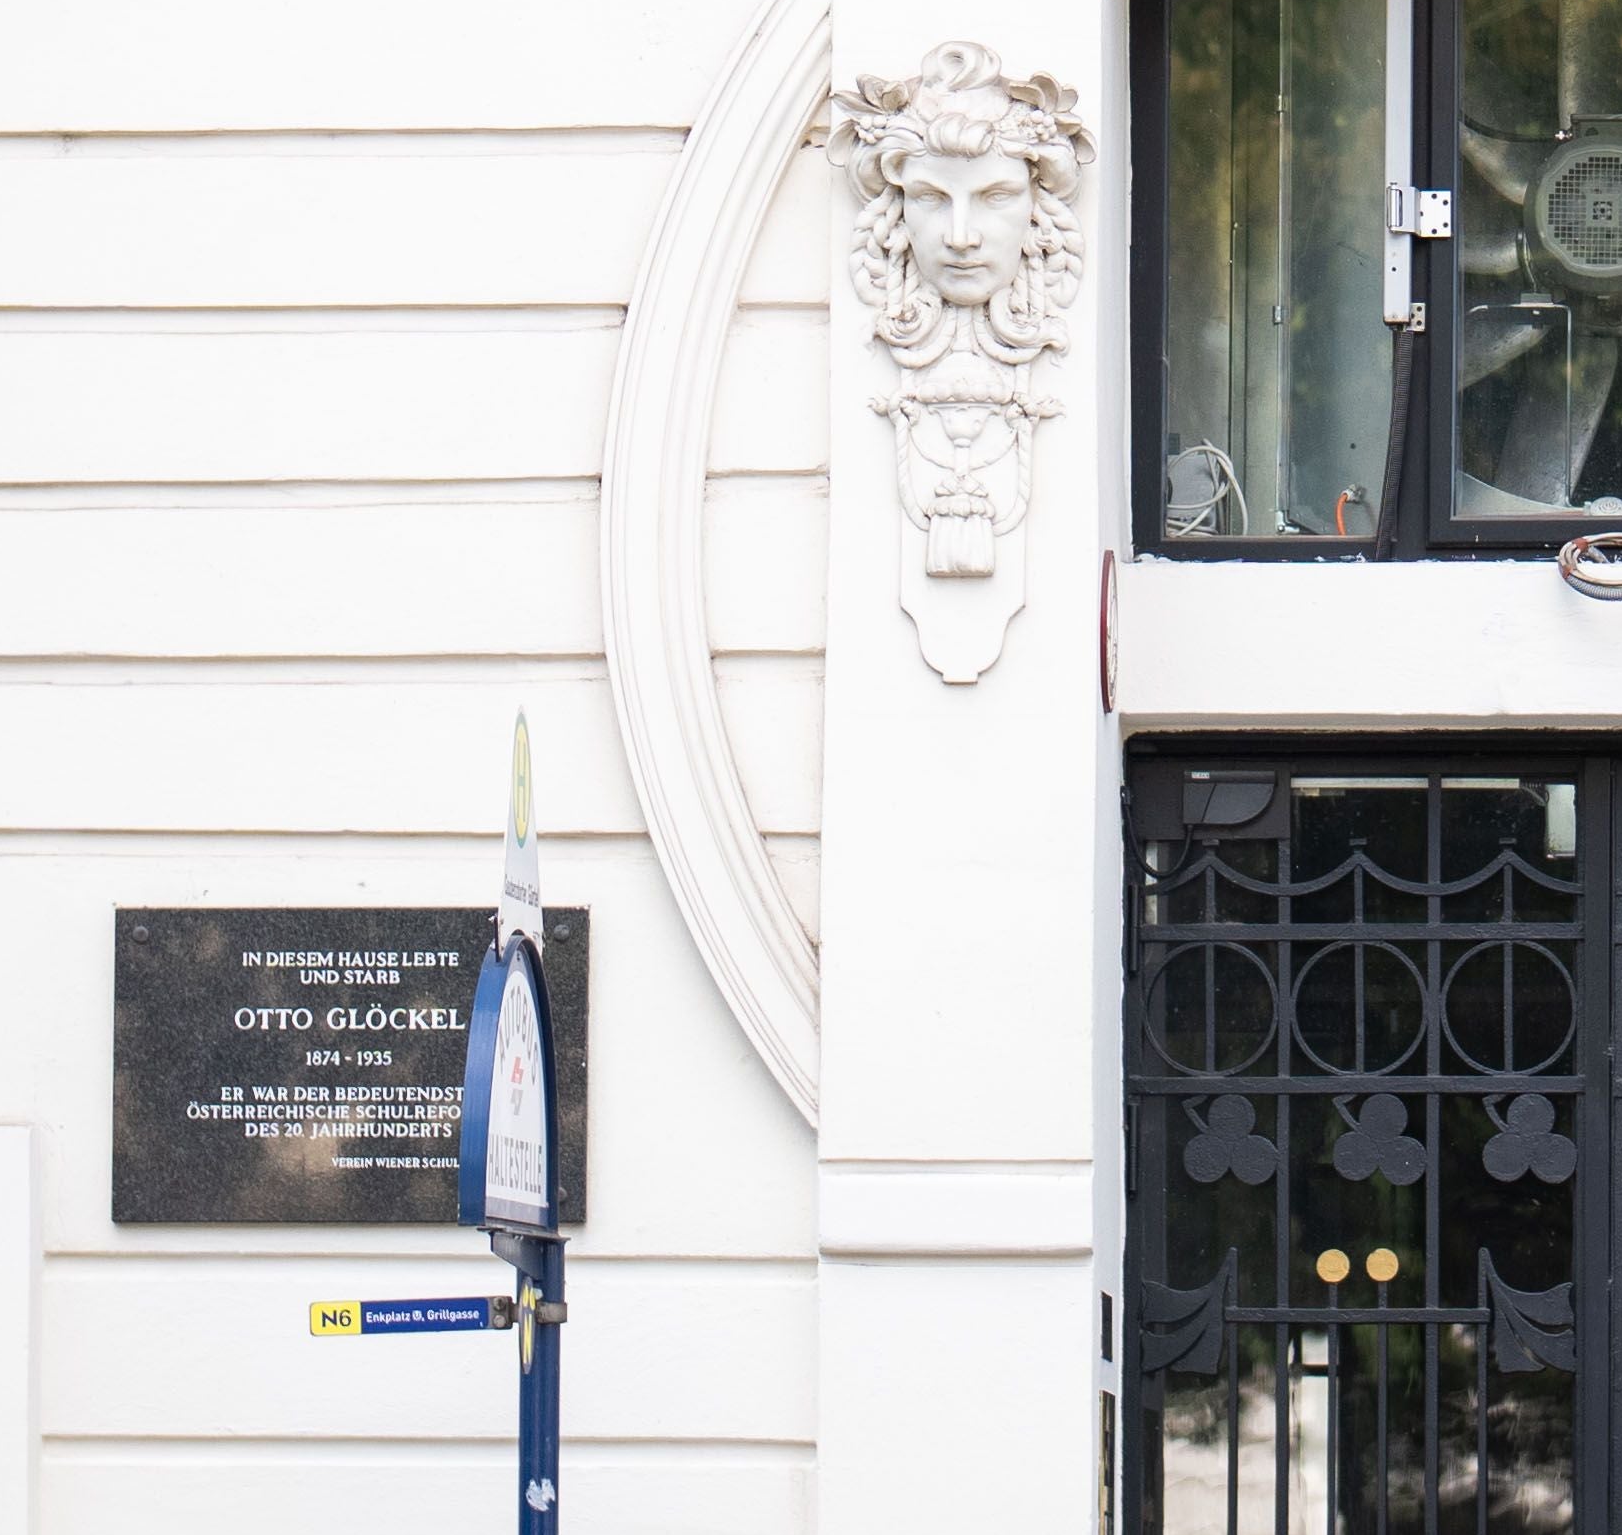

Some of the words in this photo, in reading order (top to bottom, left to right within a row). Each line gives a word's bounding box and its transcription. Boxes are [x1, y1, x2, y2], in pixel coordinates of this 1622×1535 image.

[243, 952, 262, 966] IN
[266, 952, 333, 967] DIESEM
[338, 952, 399, 967] HAUSE
[402, 952, 459, 966] LEBTE
[300, 970, 340, 985] UND
[344, 970, 400, 985] STARB
[234, 1007, 313, 1031] OTTO
[327, 1003, 466, 1031] GLÖCKEL
[306, 1050, 340, 1066] 1874
[357, 1050, 392, 1066] 1935
[221, 1087, 244, 1102] ER
[251, 1086, 289, 1102] WAR
[294, 1087, 330, 1102] DER
[186, 1101, 350, 1120] ÖSTERREICHISCHE
[244, 1122, 280, 1138] DES
[283, 1122, 305, 1139] 20.
[309, 1122, 453, 1140] JAHRHUNDERTS
[331, 1157, 373, 1169] VEREIN
[376, 1157, 421, 1169] WIENER
[487, 1132, 543, 1195] HALTESTELLE
[321, 1309, 352, 1328] N6
[365, 1310, 410, 1325] Enkplatz
[426, 1308, 480, 1324] Grillgasse
